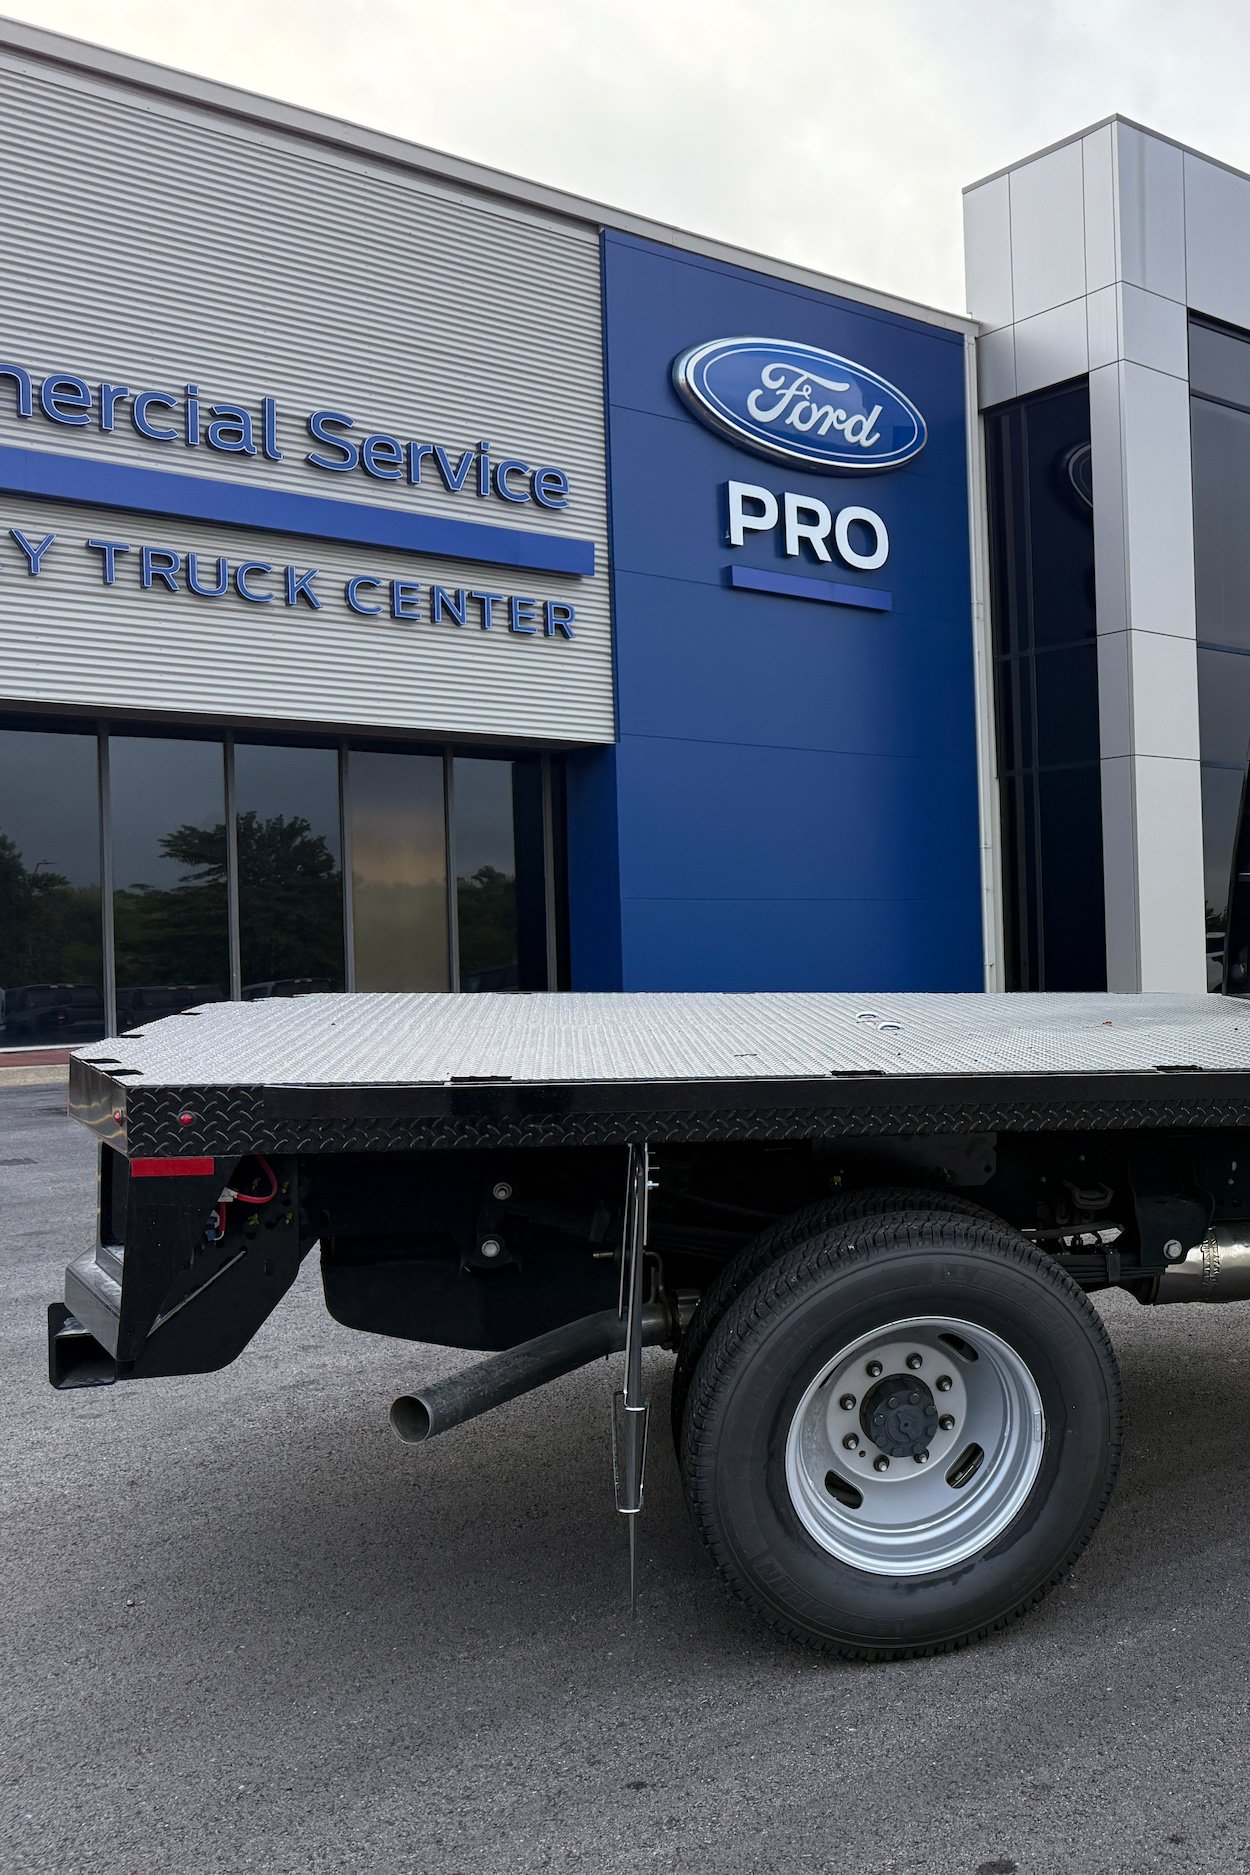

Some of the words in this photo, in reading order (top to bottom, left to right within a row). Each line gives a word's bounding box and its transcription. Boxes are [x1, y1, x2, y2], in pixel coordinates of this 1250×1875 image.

[747, 363, 882, 447] Ford
[307, 409, 571, 509] Service
[727, 480, 890, 570] PRO
[87, 538, 323, 609] TRUCK
[345, 575, 576, 640] CENTER
